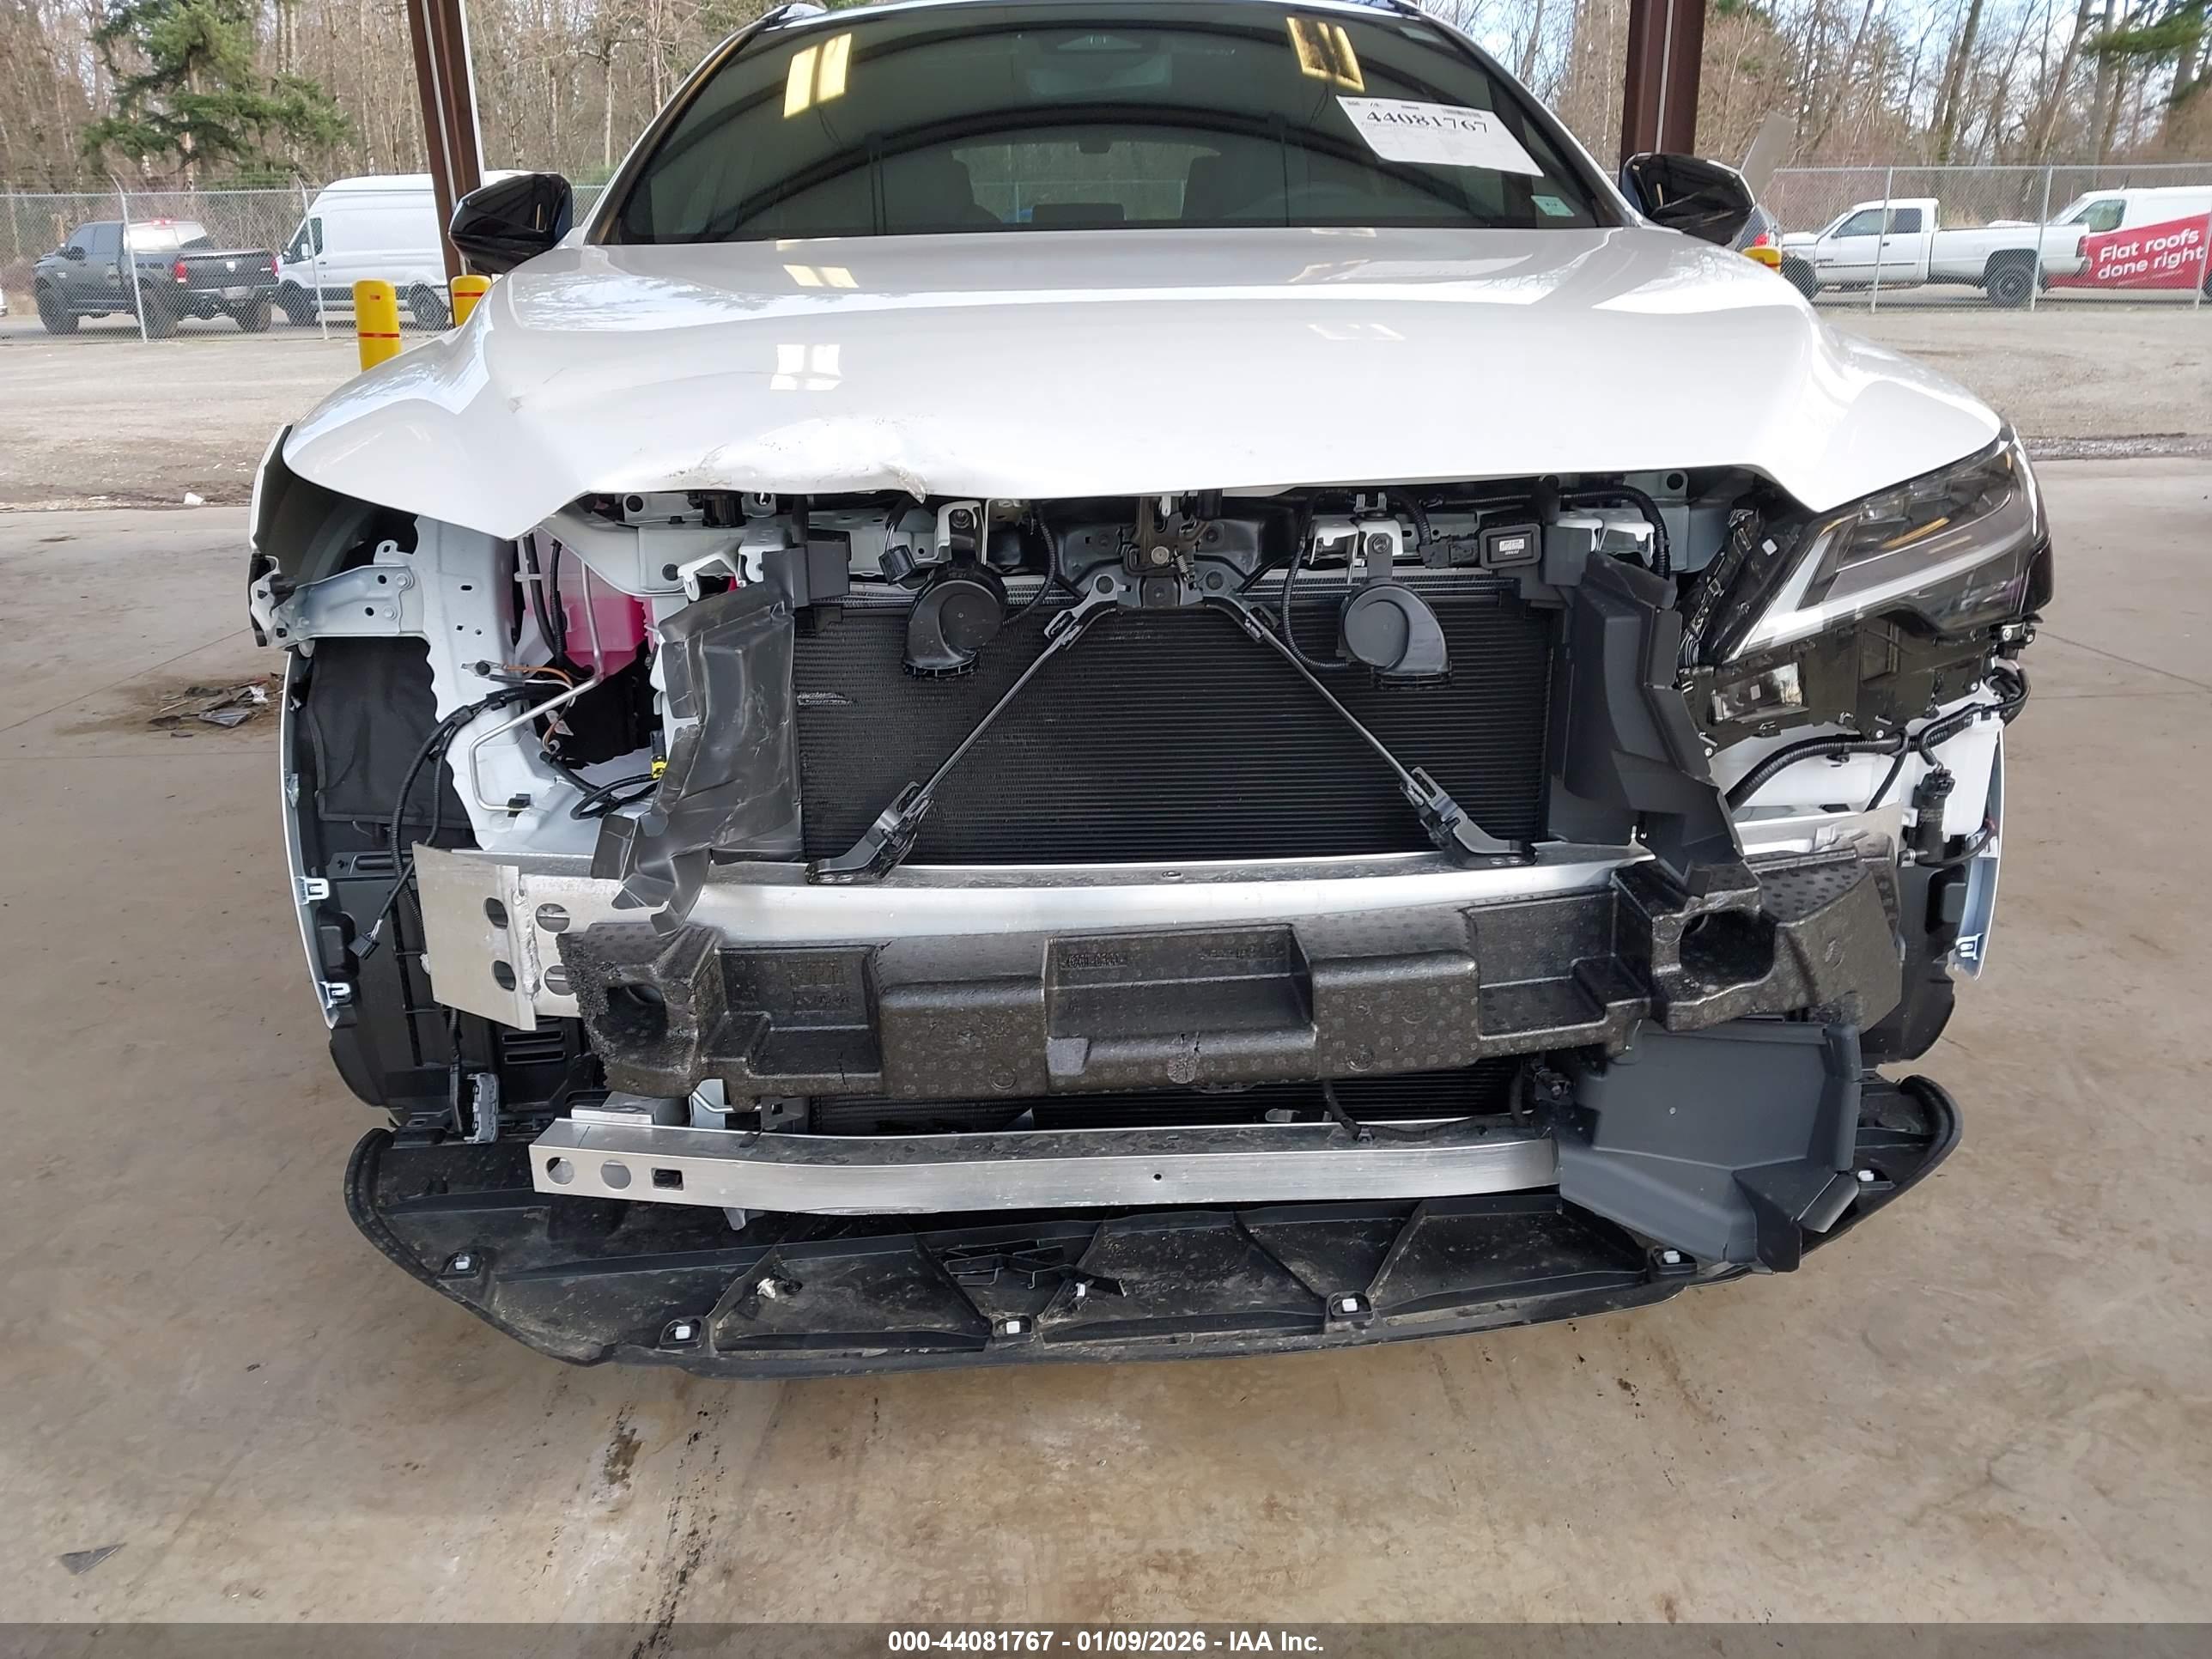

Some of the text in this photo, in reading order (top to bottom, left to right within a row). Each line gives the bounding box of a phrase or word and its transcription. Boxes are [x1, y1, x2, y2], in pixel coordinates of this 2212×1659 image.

[1367, 110, 1489, 133] 44081767
[2098, 259, 2148, 279] done
[2154, 245, 2204, 270] right
[2100, 228, 2199, 263] Flat roofs
